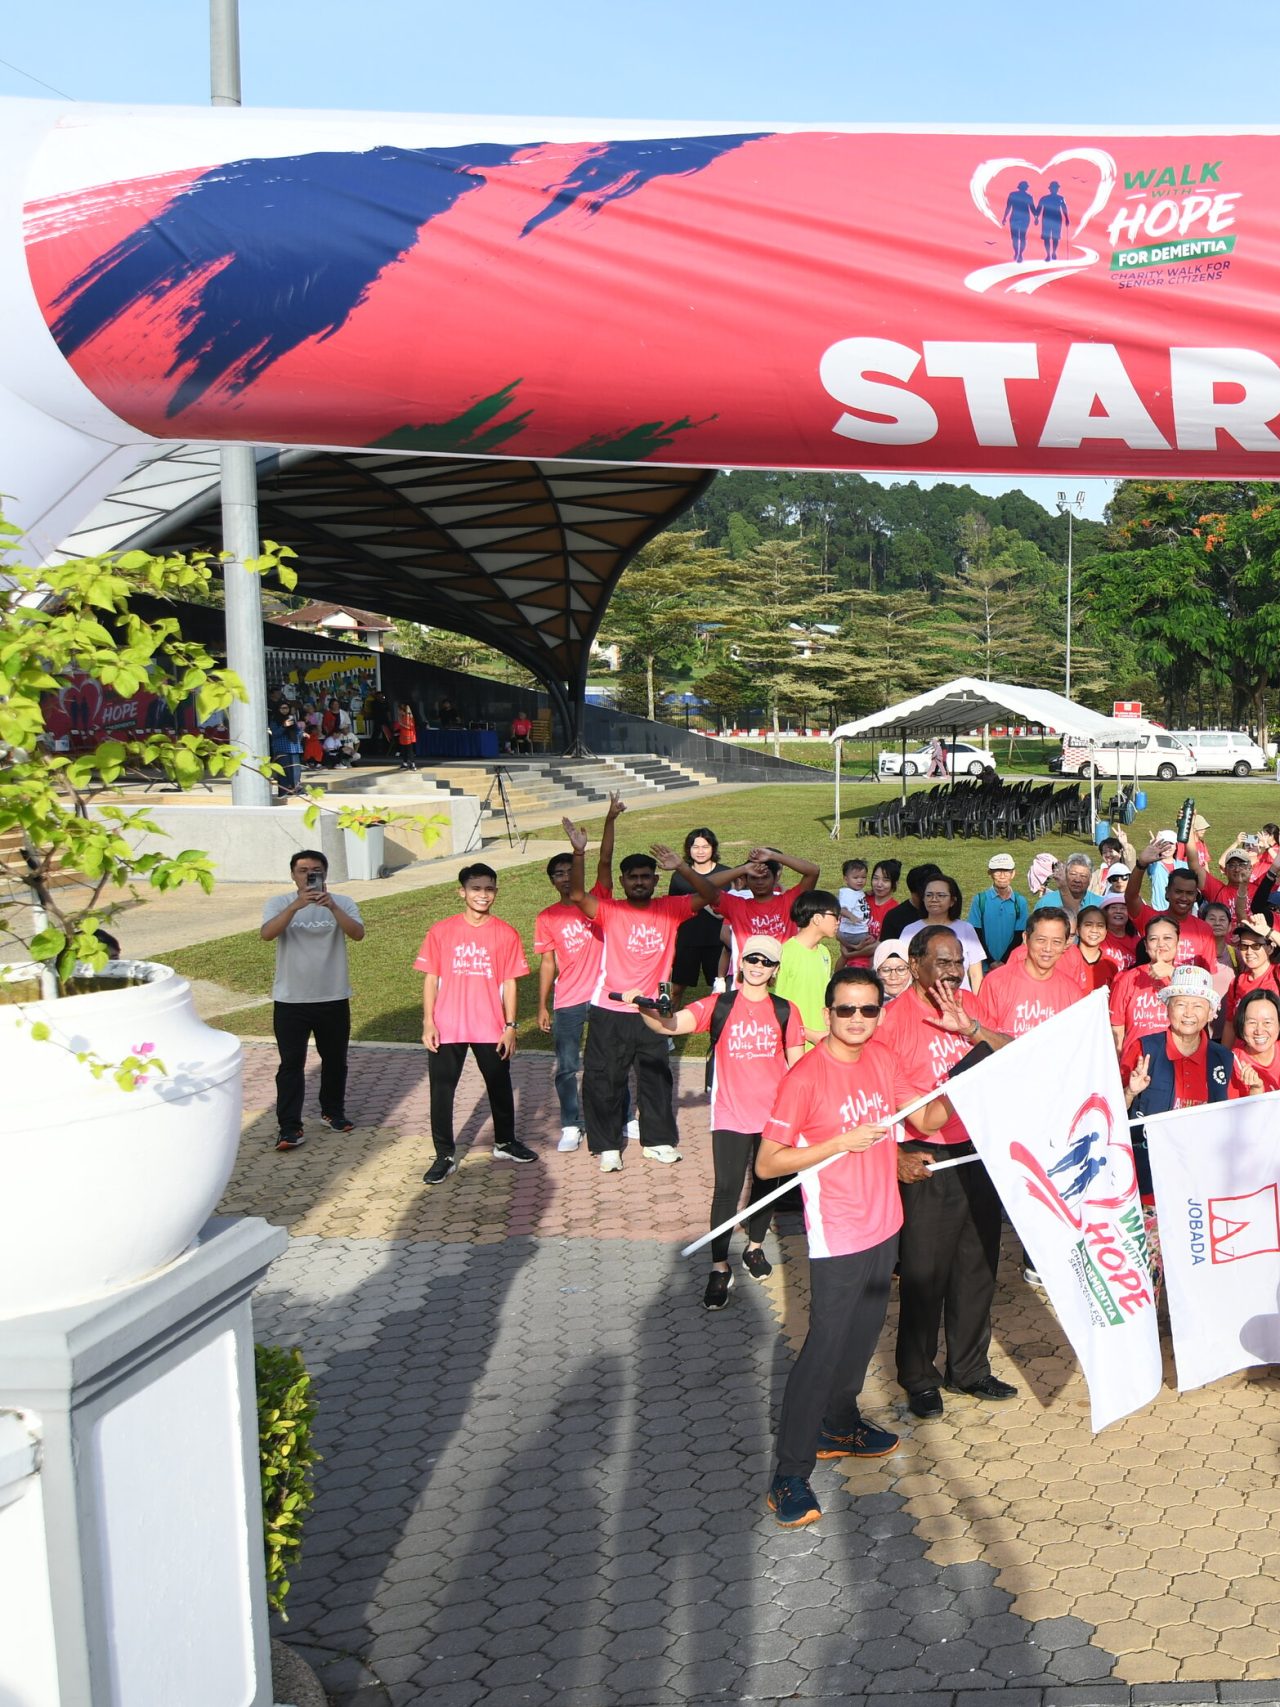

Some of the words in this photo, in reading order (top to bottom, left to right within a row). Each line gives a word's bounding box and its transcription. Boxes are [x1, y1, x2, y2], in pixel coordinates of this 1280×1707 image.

[1124, 161, 1222, 190] WALK
[1151, 188, 1192, 198] WITH
[1106, 193, 1243, 247] HOPE
[1118, 249, 1150, 267] FOR
[1151, 241, 1228, 263] DEMENTIA
[1110, 270, 1163, 281] CHARITY
[1167, 264, 1202, 276] WALK
[1206, 261, 1231, 273] FOR
[1118, 278, 1164, 289] SENIOR
[1168, 272, 1222, 286] CITIZENS
[102, 702, 138, 723] HOPE
[1133, 1007, 1154, 1021] With
[738, 1020, 774, 1039] Walk
[728, 1037, 753, 1051] With
[847, 1089, 884, 1122] Walk
[1119, 1206, 1152, 1271] WAL
[1187, 1198, 1206, 1266] JOBADA
[1121, 1239, 1143, 1269] WITH
[1084, 1222, 1152, 1316] HOPE
[1085, 1263, 1117, 1321] DEMENTIA
